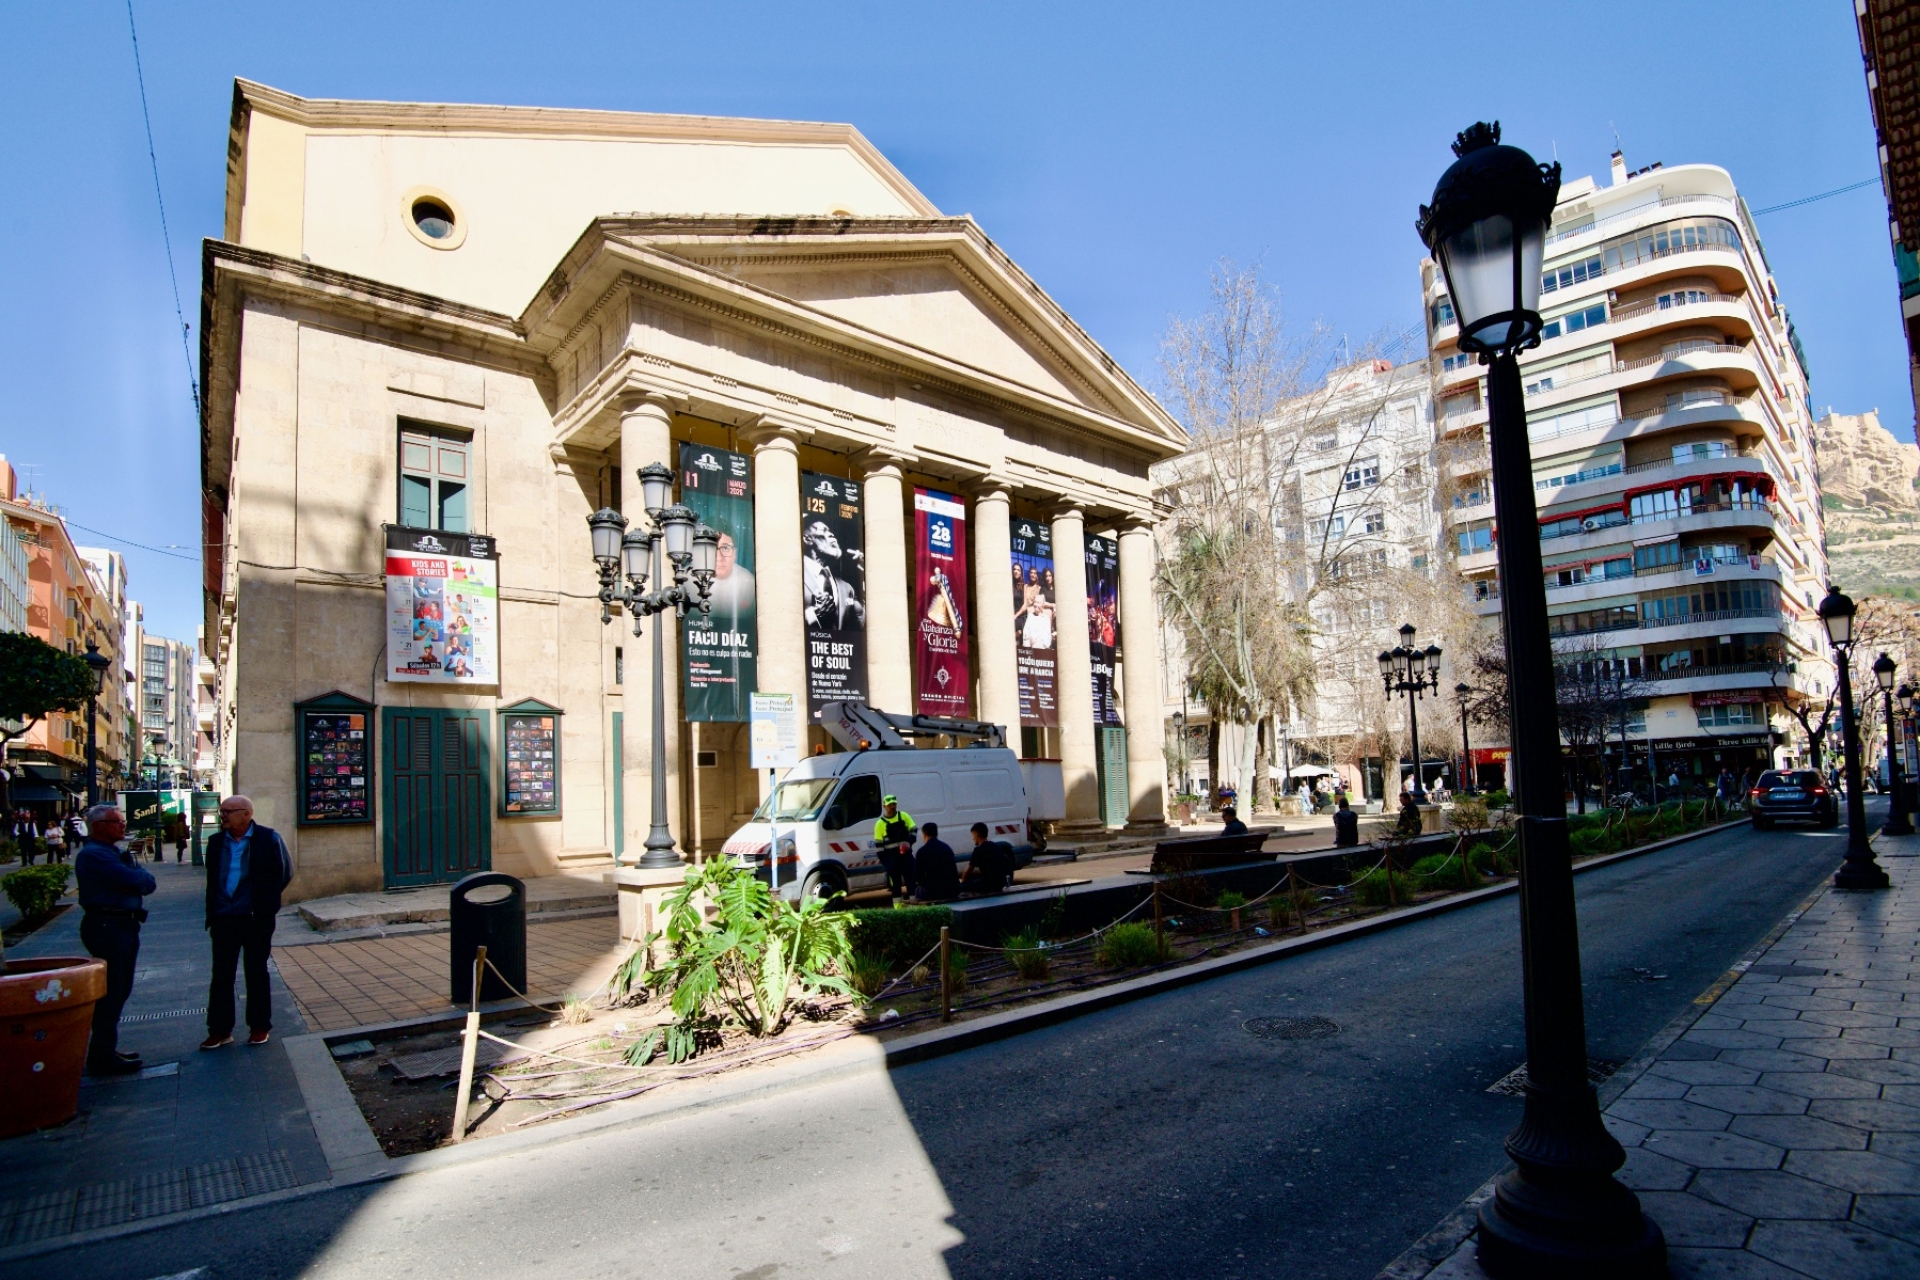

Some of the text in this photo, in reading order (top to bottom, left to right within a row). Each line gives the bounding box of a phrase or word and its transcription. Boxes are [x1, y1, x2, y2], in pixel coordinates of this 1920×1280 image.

[692, 472, 698, 488] 1
[729, 480, 747, 489] MARZO
[729, 488, 744, 496] 2026
[812, 498, 826, 513] 25
[931, 524, 951, 542] 28
[1018, 539, 1026, 551] 27
[411, 560, 429, 568] KIDS
[416, 568, 446, 576] STORIES
[918, 621, 953, 634] Alabanza
[689, 630, 748, 647] FACU DÍAZ
[810, 631, 832, 639] MÚSICA
[928, 633, 958, 649] Gloria
[689, 648, 701, 656] Esto
[716, 650, 730, 658] culpa
[811, 642, 854, 656] THE BEST
[812, 655, 851, 670] OF SOUL
[1036, 660, 1054, 668] QUIERO
[1707, 690, 1739, 699] FINCAS
[1676, 741, 1696, 749] Birds
[1717, 738, 1739, 746] Three
[133, 801, 178, 819] San Mguel
